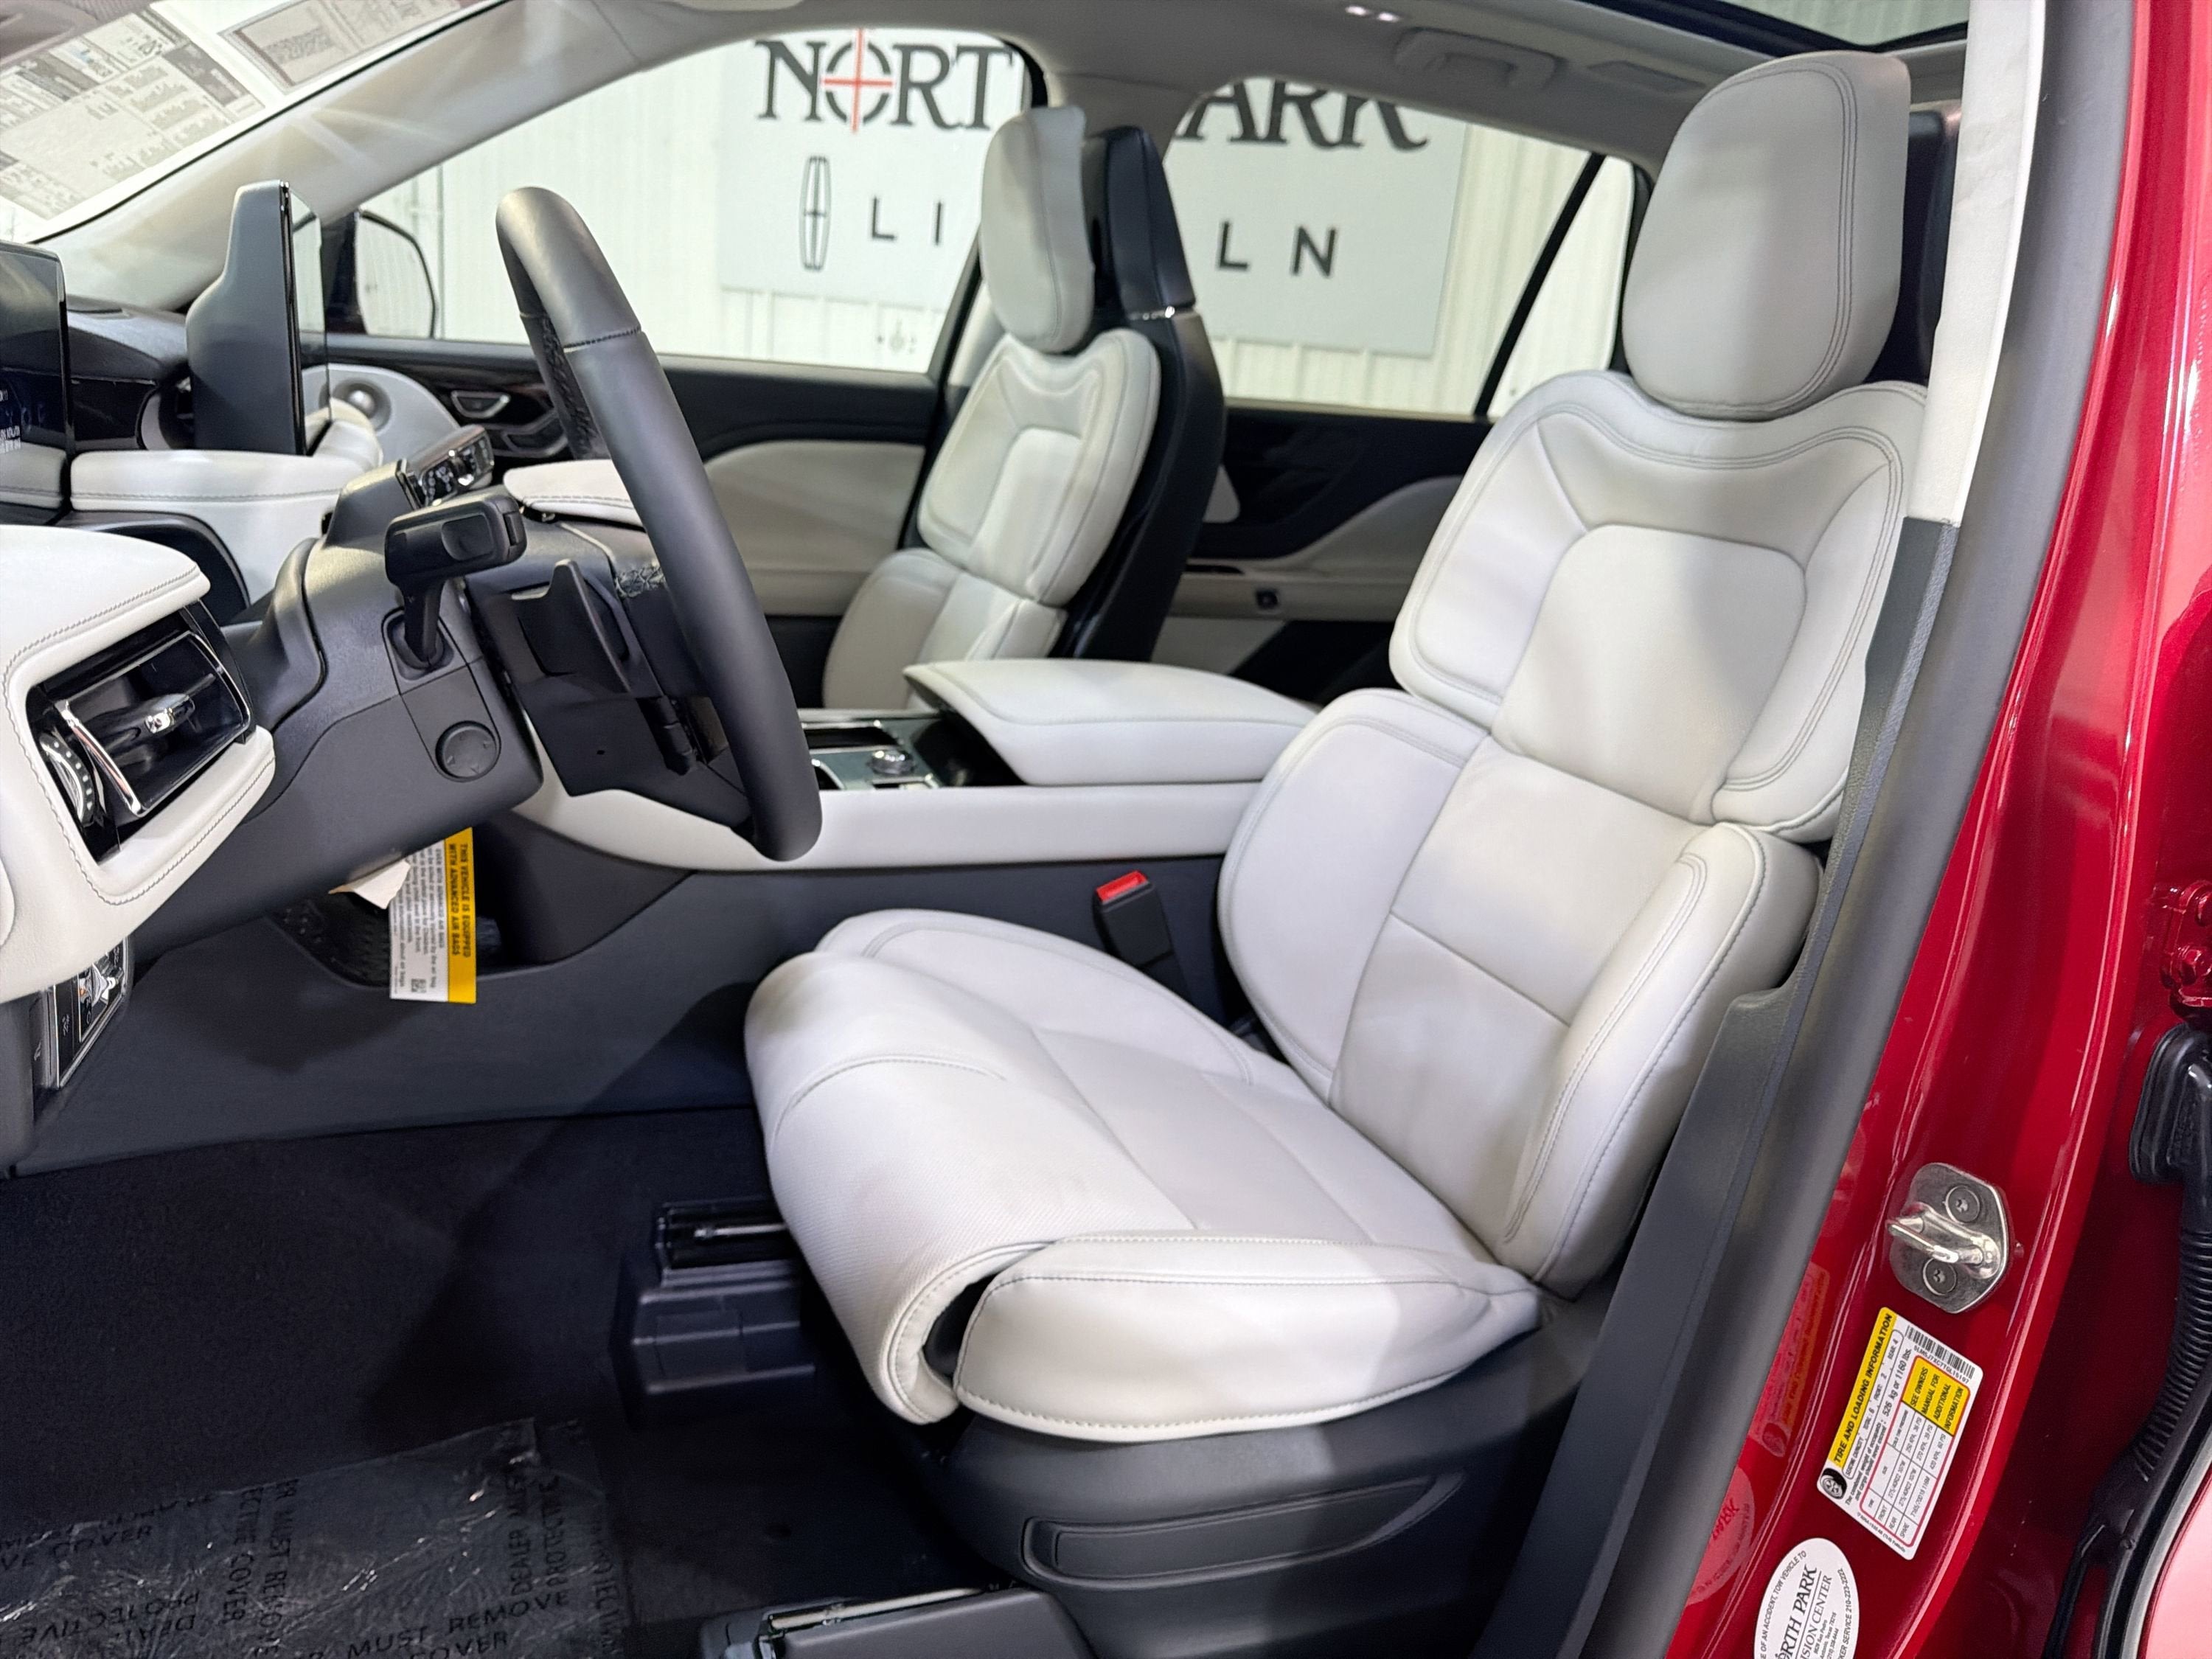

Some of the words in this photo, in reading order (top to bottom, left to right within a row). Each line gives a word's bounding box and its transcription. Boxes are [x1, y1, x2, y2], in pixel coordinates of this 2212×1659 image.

[754, 35, 1013, 131] NORT
[1175, 75, 1430, 151] ARK
[449, 844, 457, 866] WITH
[460, 844, 468, 863] THIS
[450, 869, 458, 912] ADVANCED
[461, 866, 470, 900] VEHICLE
[451, 916, 459, 931] AIR
[462, 915, 471, 957] EQUIPPED
[451, 933, 460, 955] BAGS
[1893, 1380, 1899, 1389] or
[1895, 1360, 1907, 1379] 1160
[1834, 1441, 1847, 1462] TIRE
[1843, 1421, 1854, 1441] AND
[1851, 1379, 1869, 1419] LOADING
[1865, 1313, 1892, 1378] INFORMATION
[1888, 1389, 1898, 1400] kg
[1910, 1394, 1919, 1407] SEE
[1915, 1367, 1928, 1394] OWNERS
[1921, 1389, 1935, 1414] MANUAL
[1930, 1374, 1940, 1388] FOR
[1933, 1384, 1951, 1421] ADDITIONAL
[1882, 1401, 1892, 1416] 526
[1944, 1387, 1963, 1430] INFORMATION
[1850, 1470, 1863, 1495] combined
[1860, 1453, 1870, 1471] weight
[1869, 1422, 1882, 1448] occupants
[1859, 1475, 1868, 1490] cargo
[1865, 1458, 1874, 1475] should
[1871, 1444, 1879, 1458] never
[53, 1524, 152, 1558] COVER
[1798, 1551, 1806, 1560] TO
[509, 1528, 533, 1596] DEALER
[1781, 1557, 1800, 1580] VEHICLE
[223, 1553, 254, 1622] COVER
[1774, 1579, 1784, 1595] TOW
[1792, 1564, 1818, 1615] PARK
[1812, 1575, 1832, 1624] CENTER
[347, 1626, 428, 1659] MUST
[449, 1591, 570, 1633] REMOVE
[1764, 1596, 1778, 1630] ACCIDENT,
[1843, 1613, 1851, 1644] SERVICE
[1761, 1630, 1768, 1641] AN
[1761, 1642, 1767, 1652] OF
